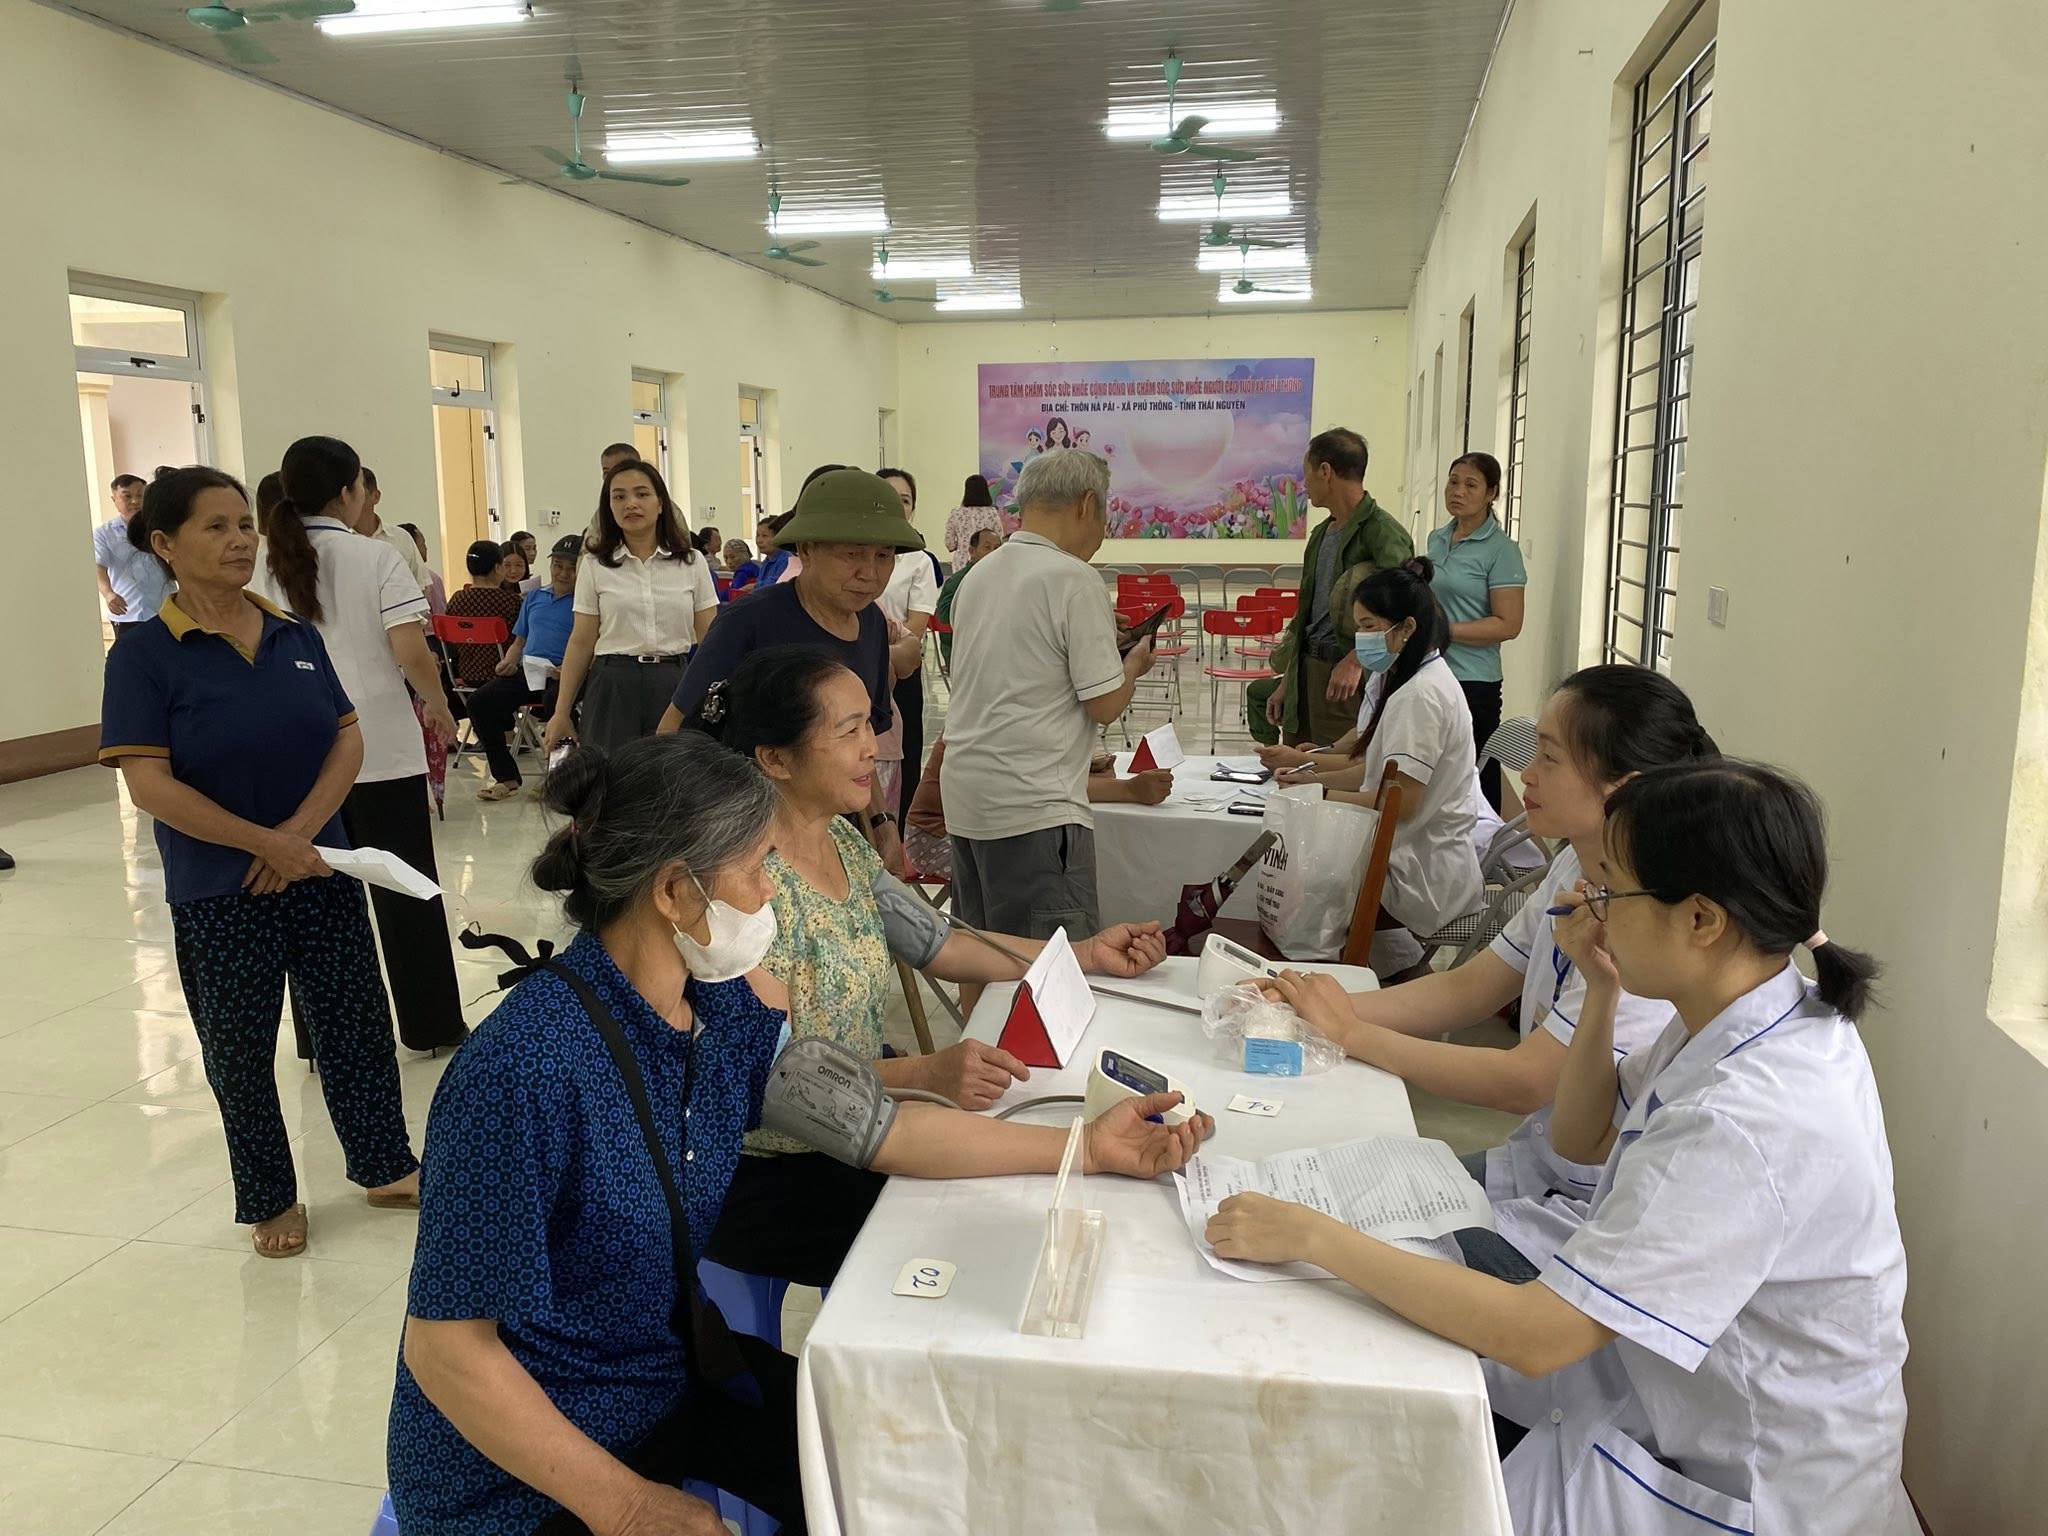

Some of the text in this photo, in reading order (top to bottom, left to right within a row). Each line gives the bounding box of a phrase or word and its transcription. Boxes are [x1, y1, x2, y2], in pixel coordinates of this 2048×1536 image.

[989, 384, 1009, 398] TRUNG
[1010, 382, 1024, 398] TÂM
[1024, 381, 1043, 398] CHĂM
[1044, 381, 1057, 397] SÓC
[1058, 380, 1071, 397] SỨC
[1090, 380, 1107, 399] CỘNG
[1127, 380, 1136, 396] VÀ
[1136, 379, 1156, 396] CHĂM
[1157, 378, 1169, 395] SÓC
[1171, 378, 1184, 395] SỨC
[1041, 402, 1053, 414] ĐỊA
[1055, 400, 1069, 412] CHỈ:
[1071, 402, 1089, 412] THÔN
[1103, 401, 1115, 411] PÁI
[1121, 401, 1131, 411] XÃ
[1133, 399, 1147, 411] PHỦ
[1149, 400, 1173, 411] THÔNG
[1180, 398, 1196, 410] TỈNH
[1198, 399, 1214, 410] THÁI
[1216, 399, 1246, 410] NGUYÊN
[817, 1065, 852, 1089] OMRON
[912, 1267, 940, 1289] 02
